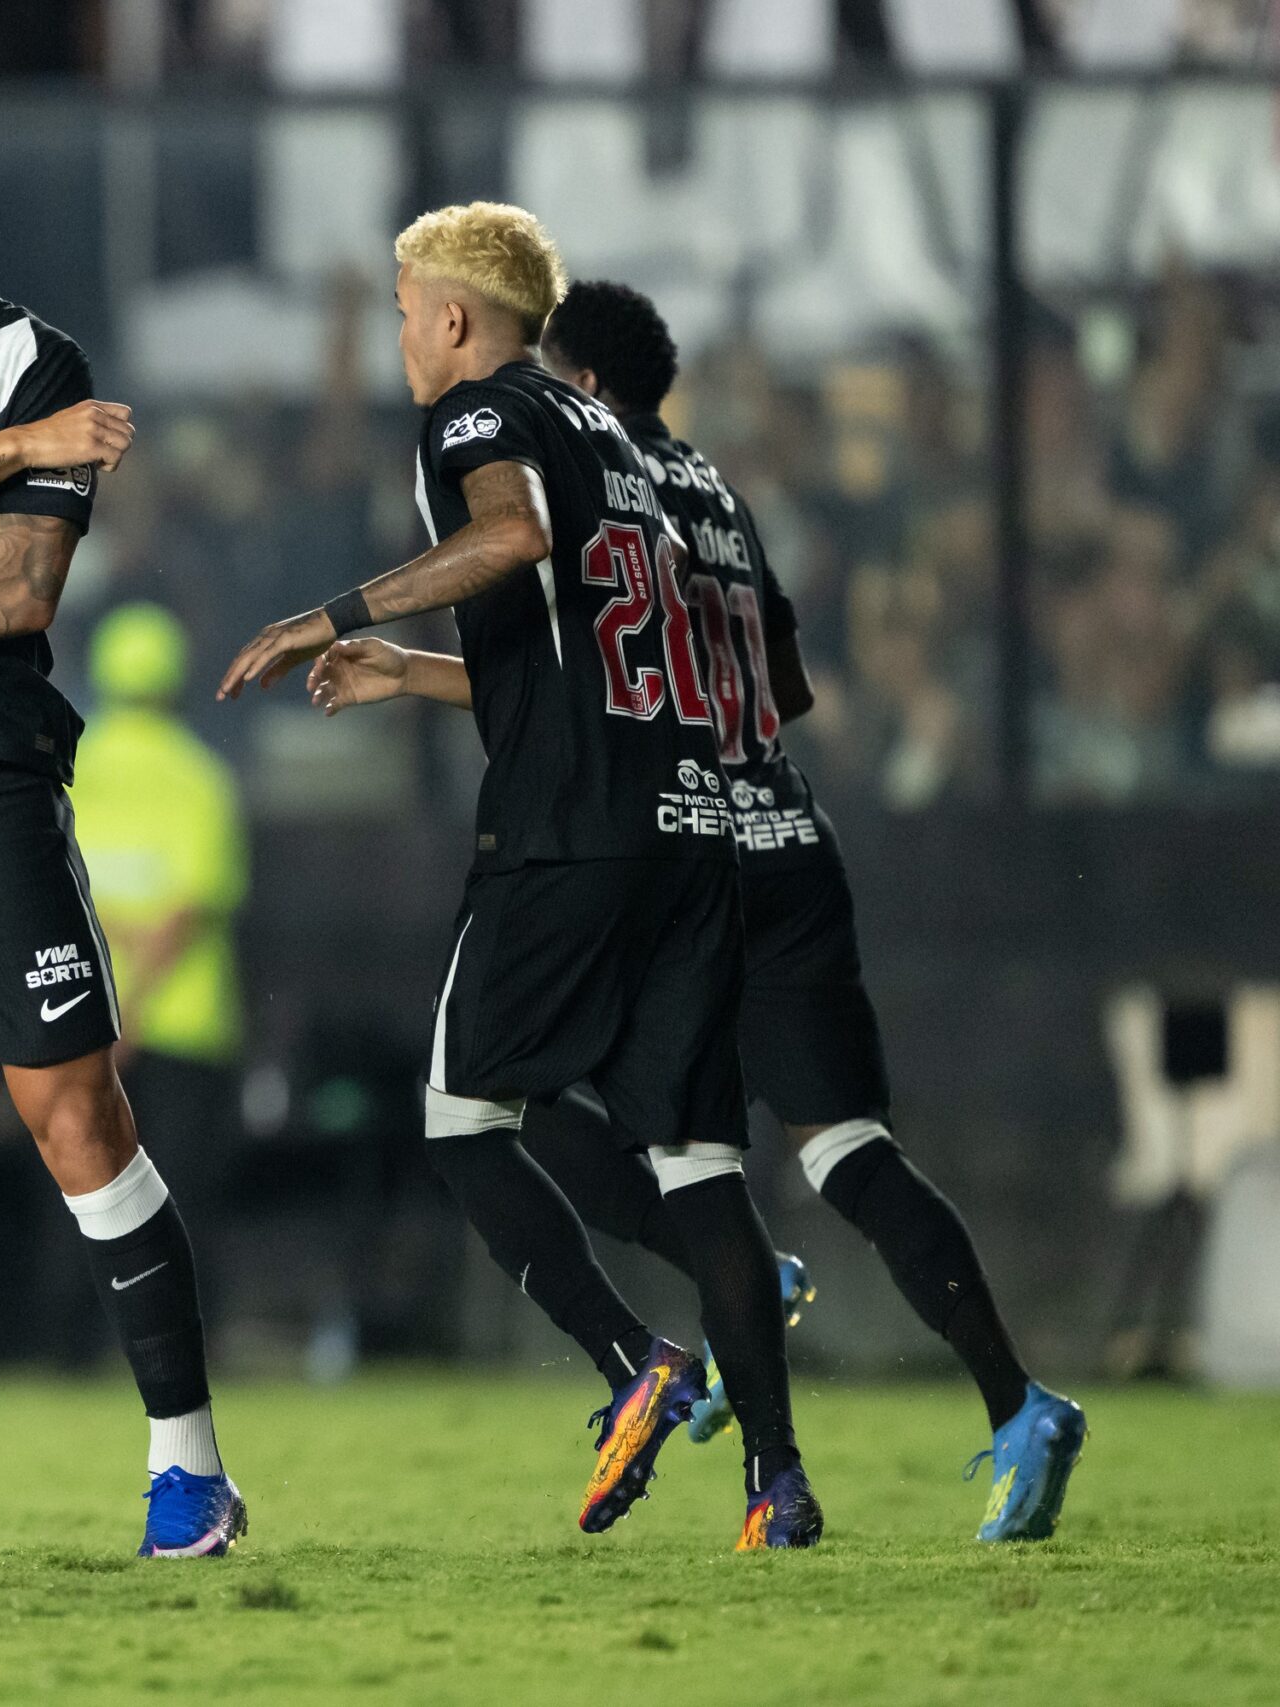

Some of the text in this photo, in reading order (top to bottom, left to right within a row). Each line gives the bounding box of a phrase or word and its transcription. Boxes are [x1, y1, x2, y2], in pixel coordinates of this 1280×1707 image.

[28, 476, 66, 487] DELIVERY
[627, 542, 643, 579] SCORE
[684, 794, 727, 808] MOTO
[657, 805, 730, 836] CHEF
[736, 810, 782, 825] MOTO
[736, 818, 820, 851] HEFE
[35, 944, 79, 968] VIVA
[25, 961, 94, 989] SORTE
